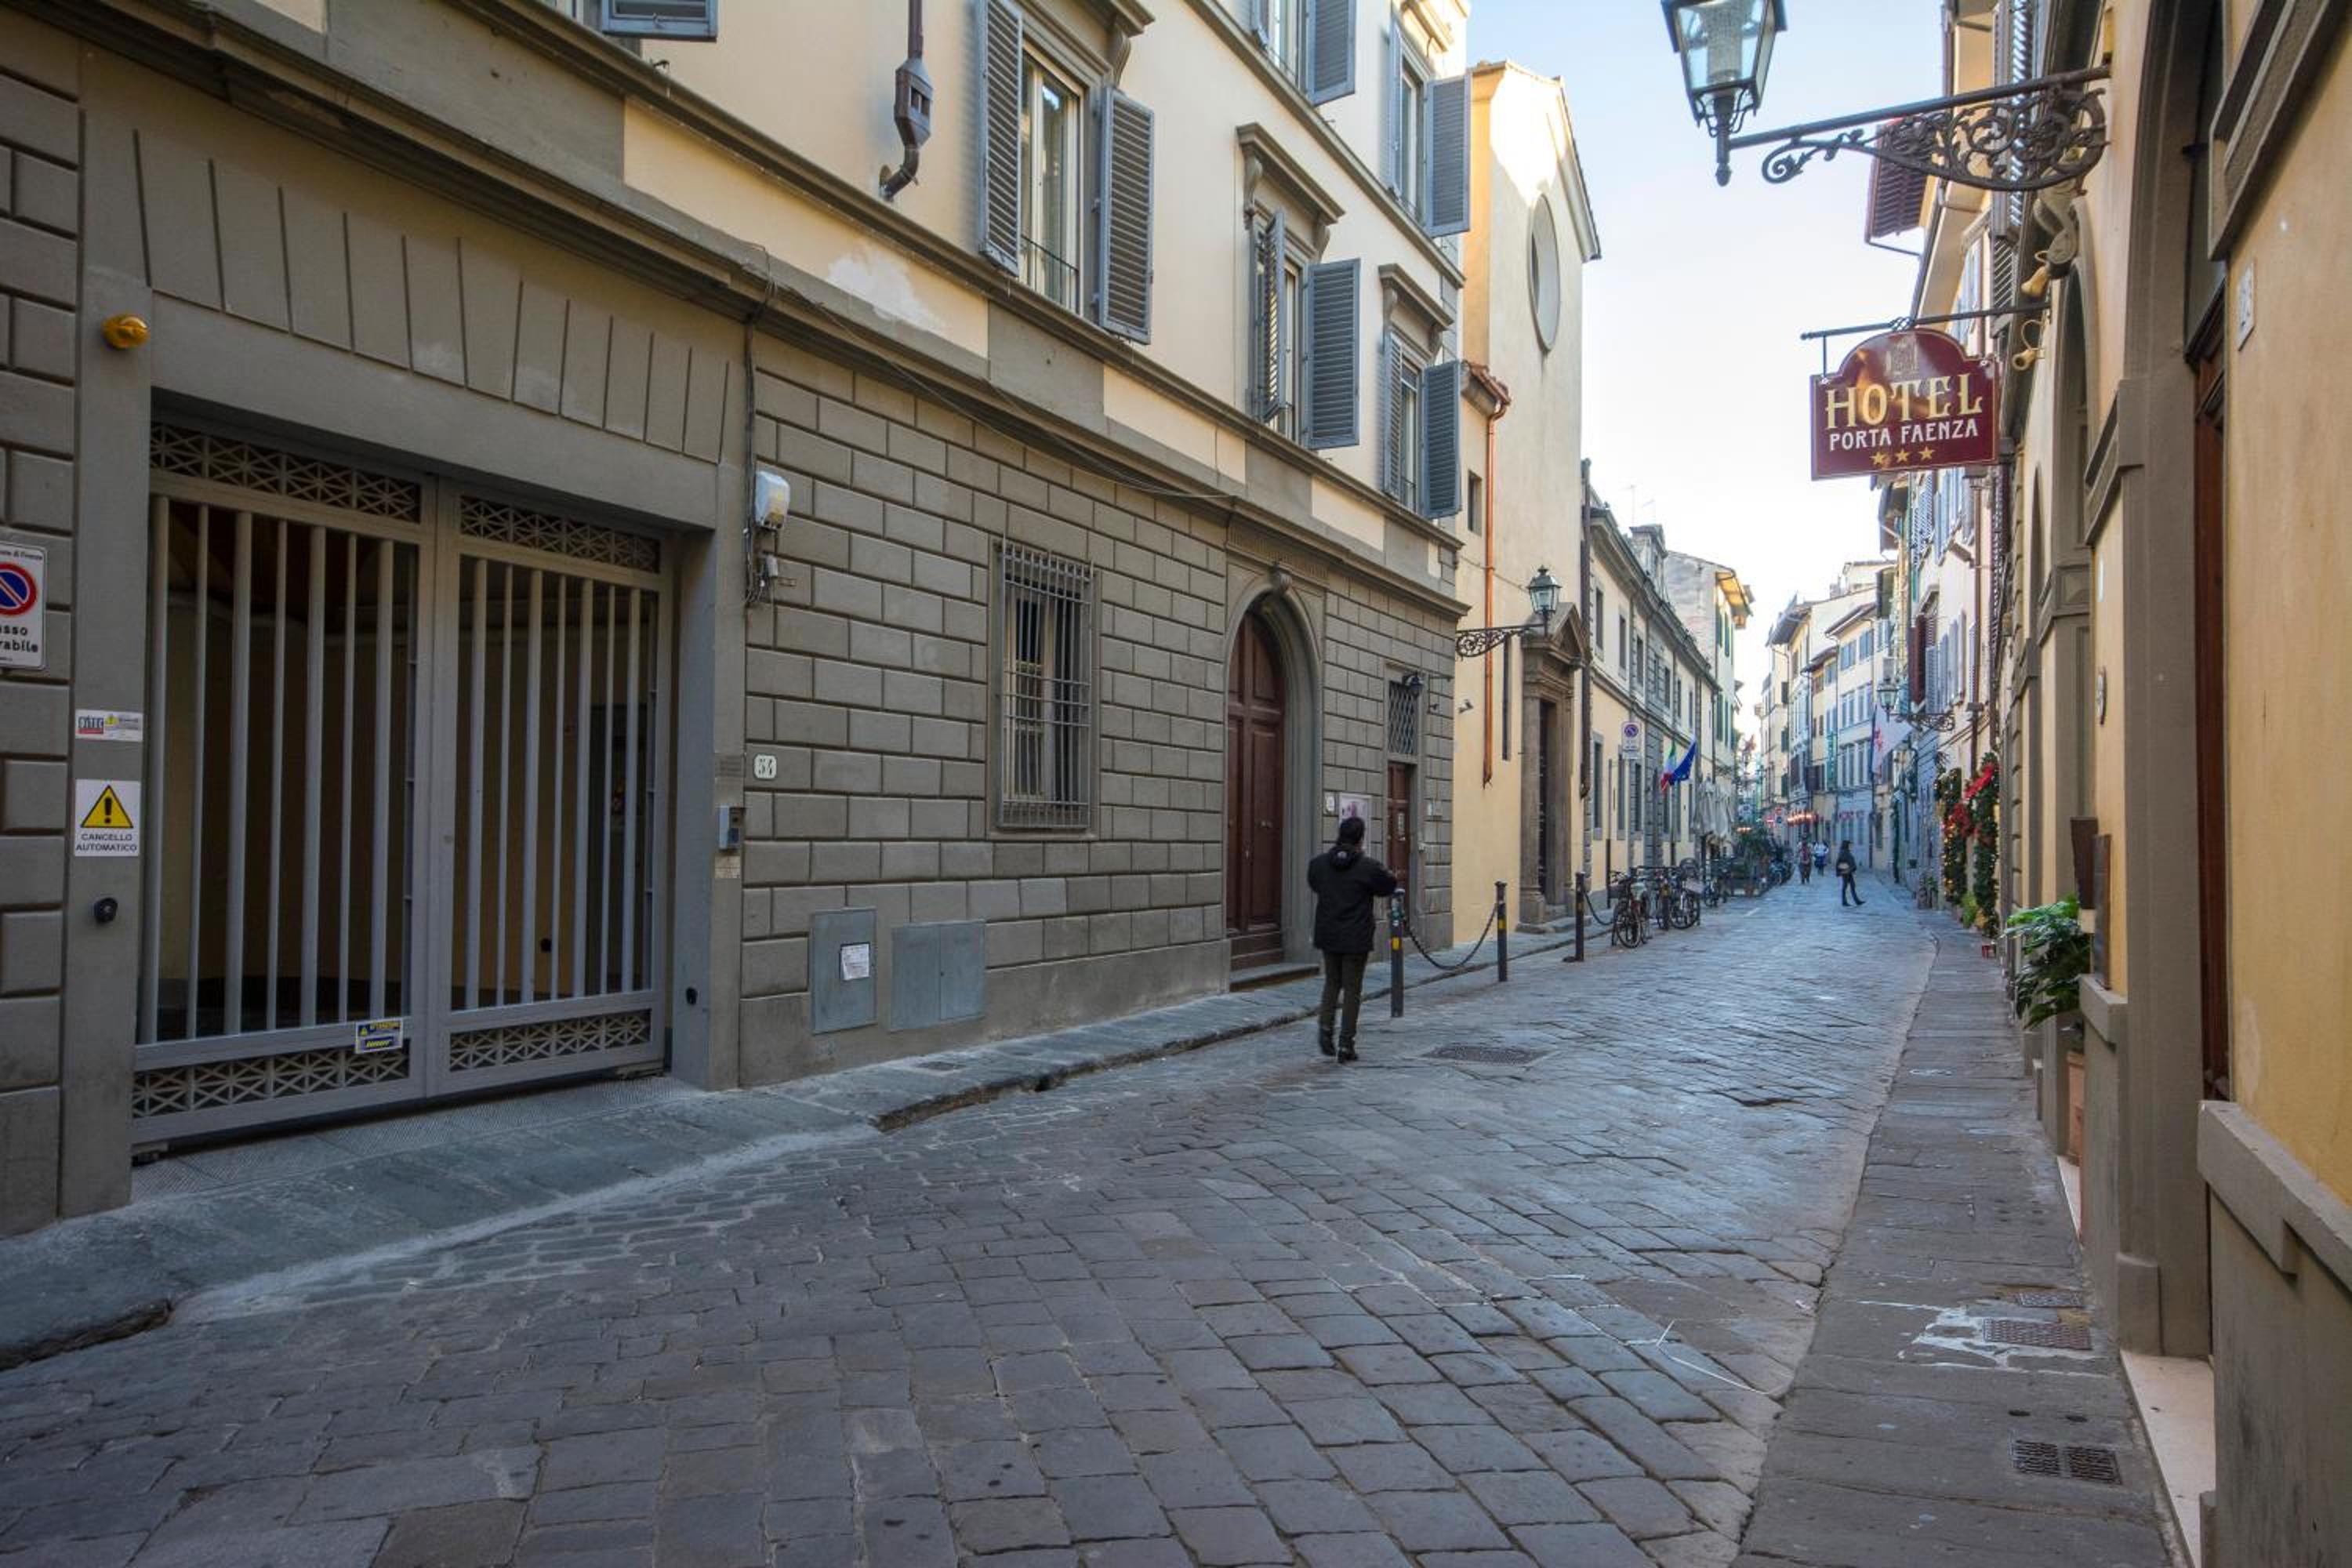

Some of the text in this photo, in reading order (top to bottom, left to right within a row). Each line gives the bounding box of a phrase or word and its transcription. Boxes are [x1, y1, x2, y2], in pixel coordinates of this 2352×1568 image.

[1825, 373, 1983, 430] HOTEL
[1829, 418, 1978, 451] PORTA FAENZA
[0, 625, 28, 636] sso
[81, 833, 132, 841] CANCELLO
[75, 843, 137, 852] AUTOMATICO
